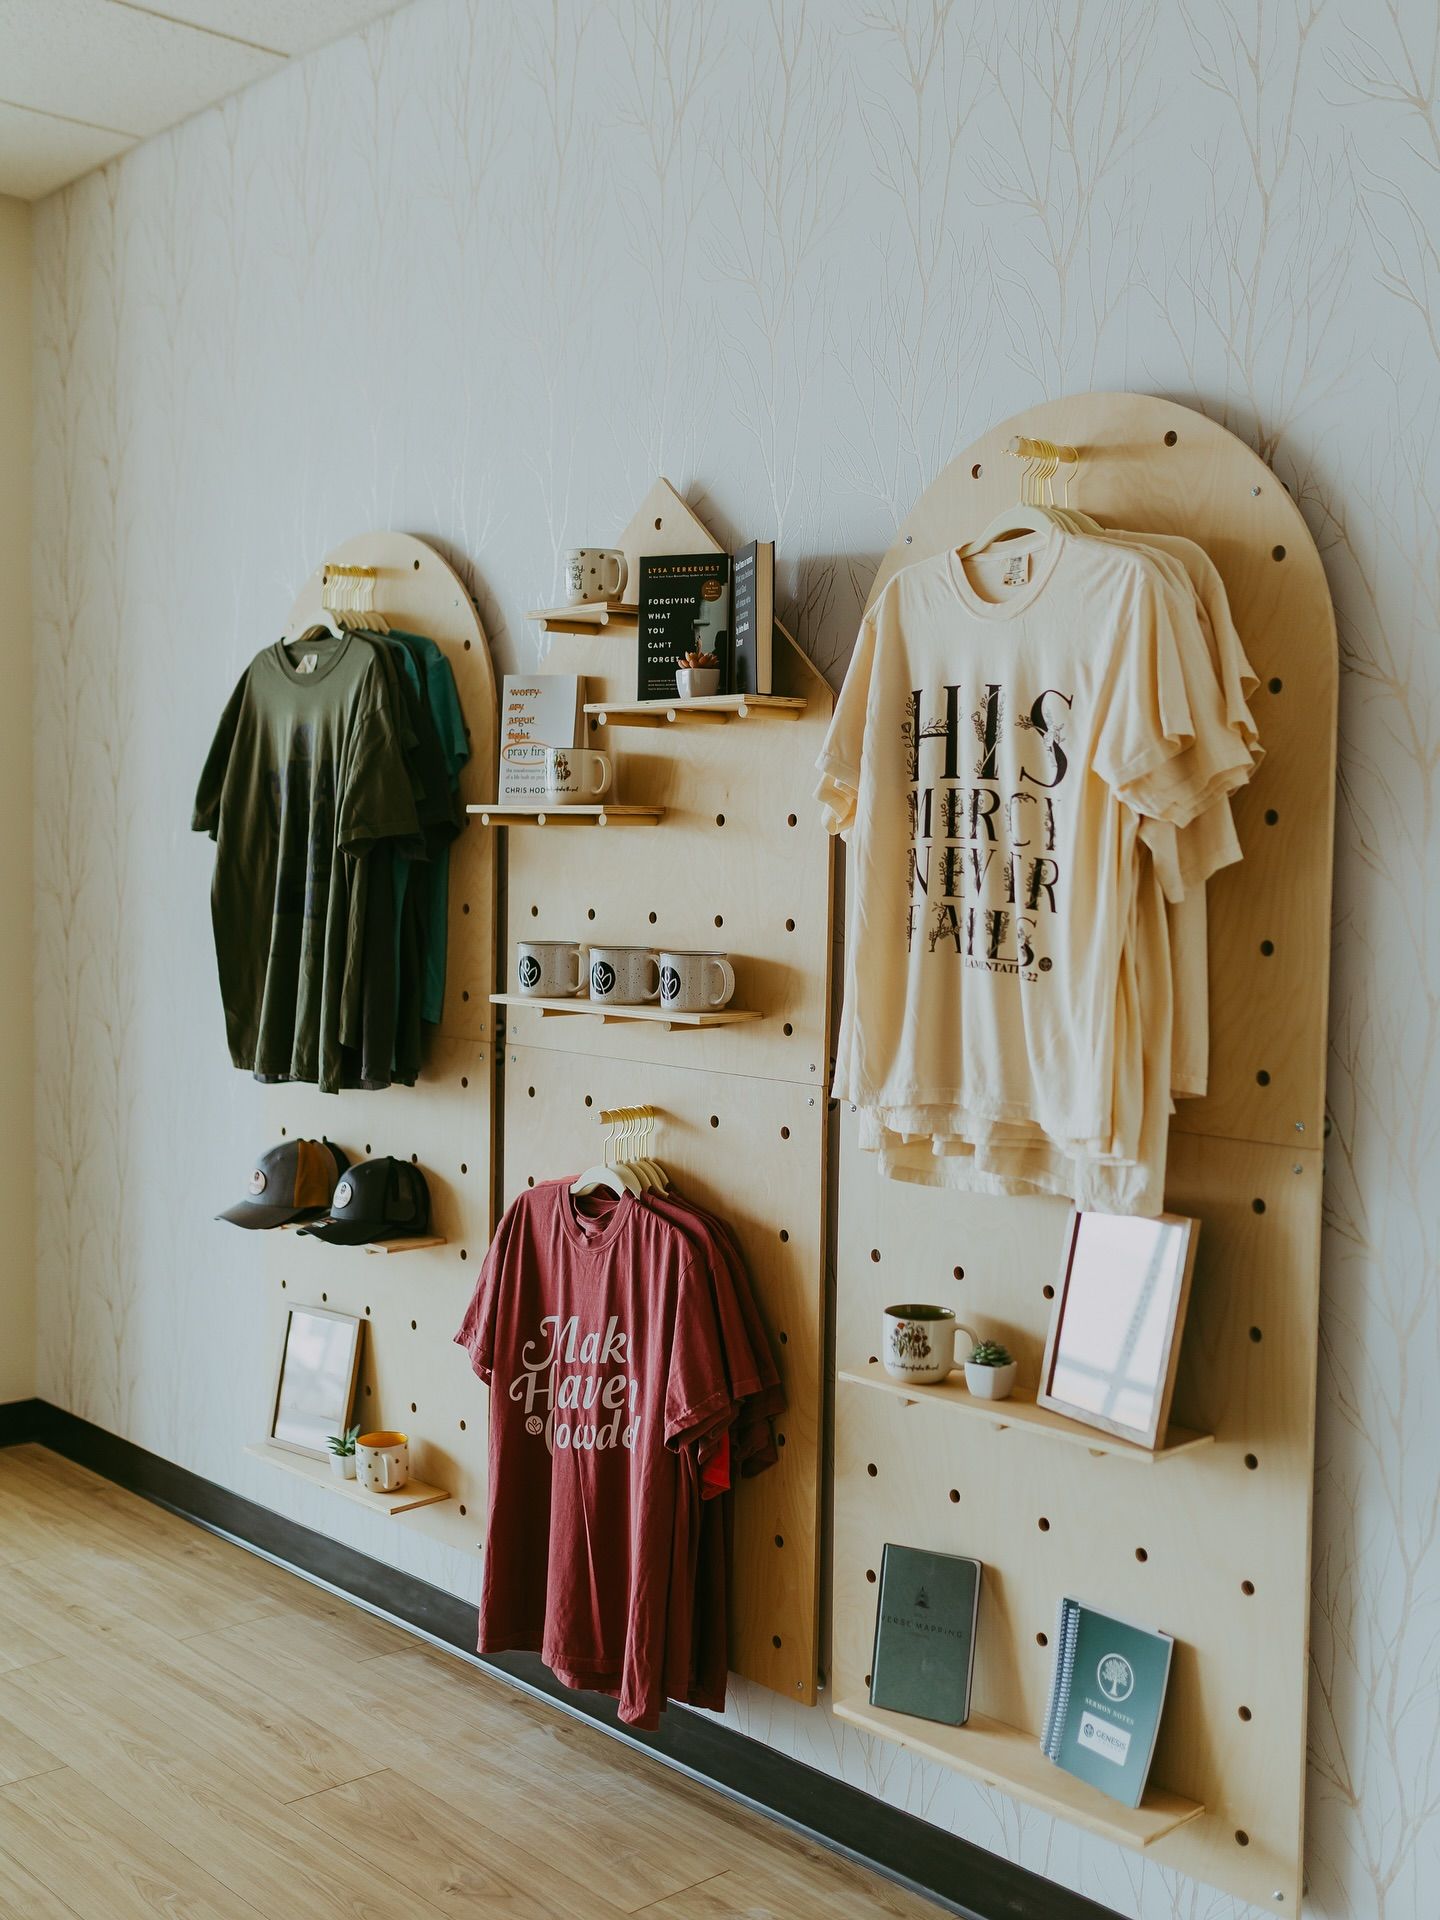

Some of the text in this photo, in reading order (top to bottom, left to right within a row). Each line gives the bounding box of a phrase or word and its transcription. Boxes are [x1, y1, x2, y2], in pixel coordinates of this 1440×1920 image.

[671, 565, 720, 573] TERKEURST
[648, 597, 696, 605] FORGIVING
[647, 612, 671, 620] WHAT
[647, 627, 665, 635] YOU
[647, 641, 672, 649] CAN'T
[509, 688, 540, 698] worry
[507, 716, 535, 727] argue
[908, 684, 1073, 788] HIS
[507, 745, 546, 759] pray firs
[881, 1615, 913, 1628] VERSE
[916, 1623, 963, 1639] MAPPING
[1085, 1696, 1134, 1726] SERMON NOTES
[1095, 1730, 1127, 1751] GENESIS
